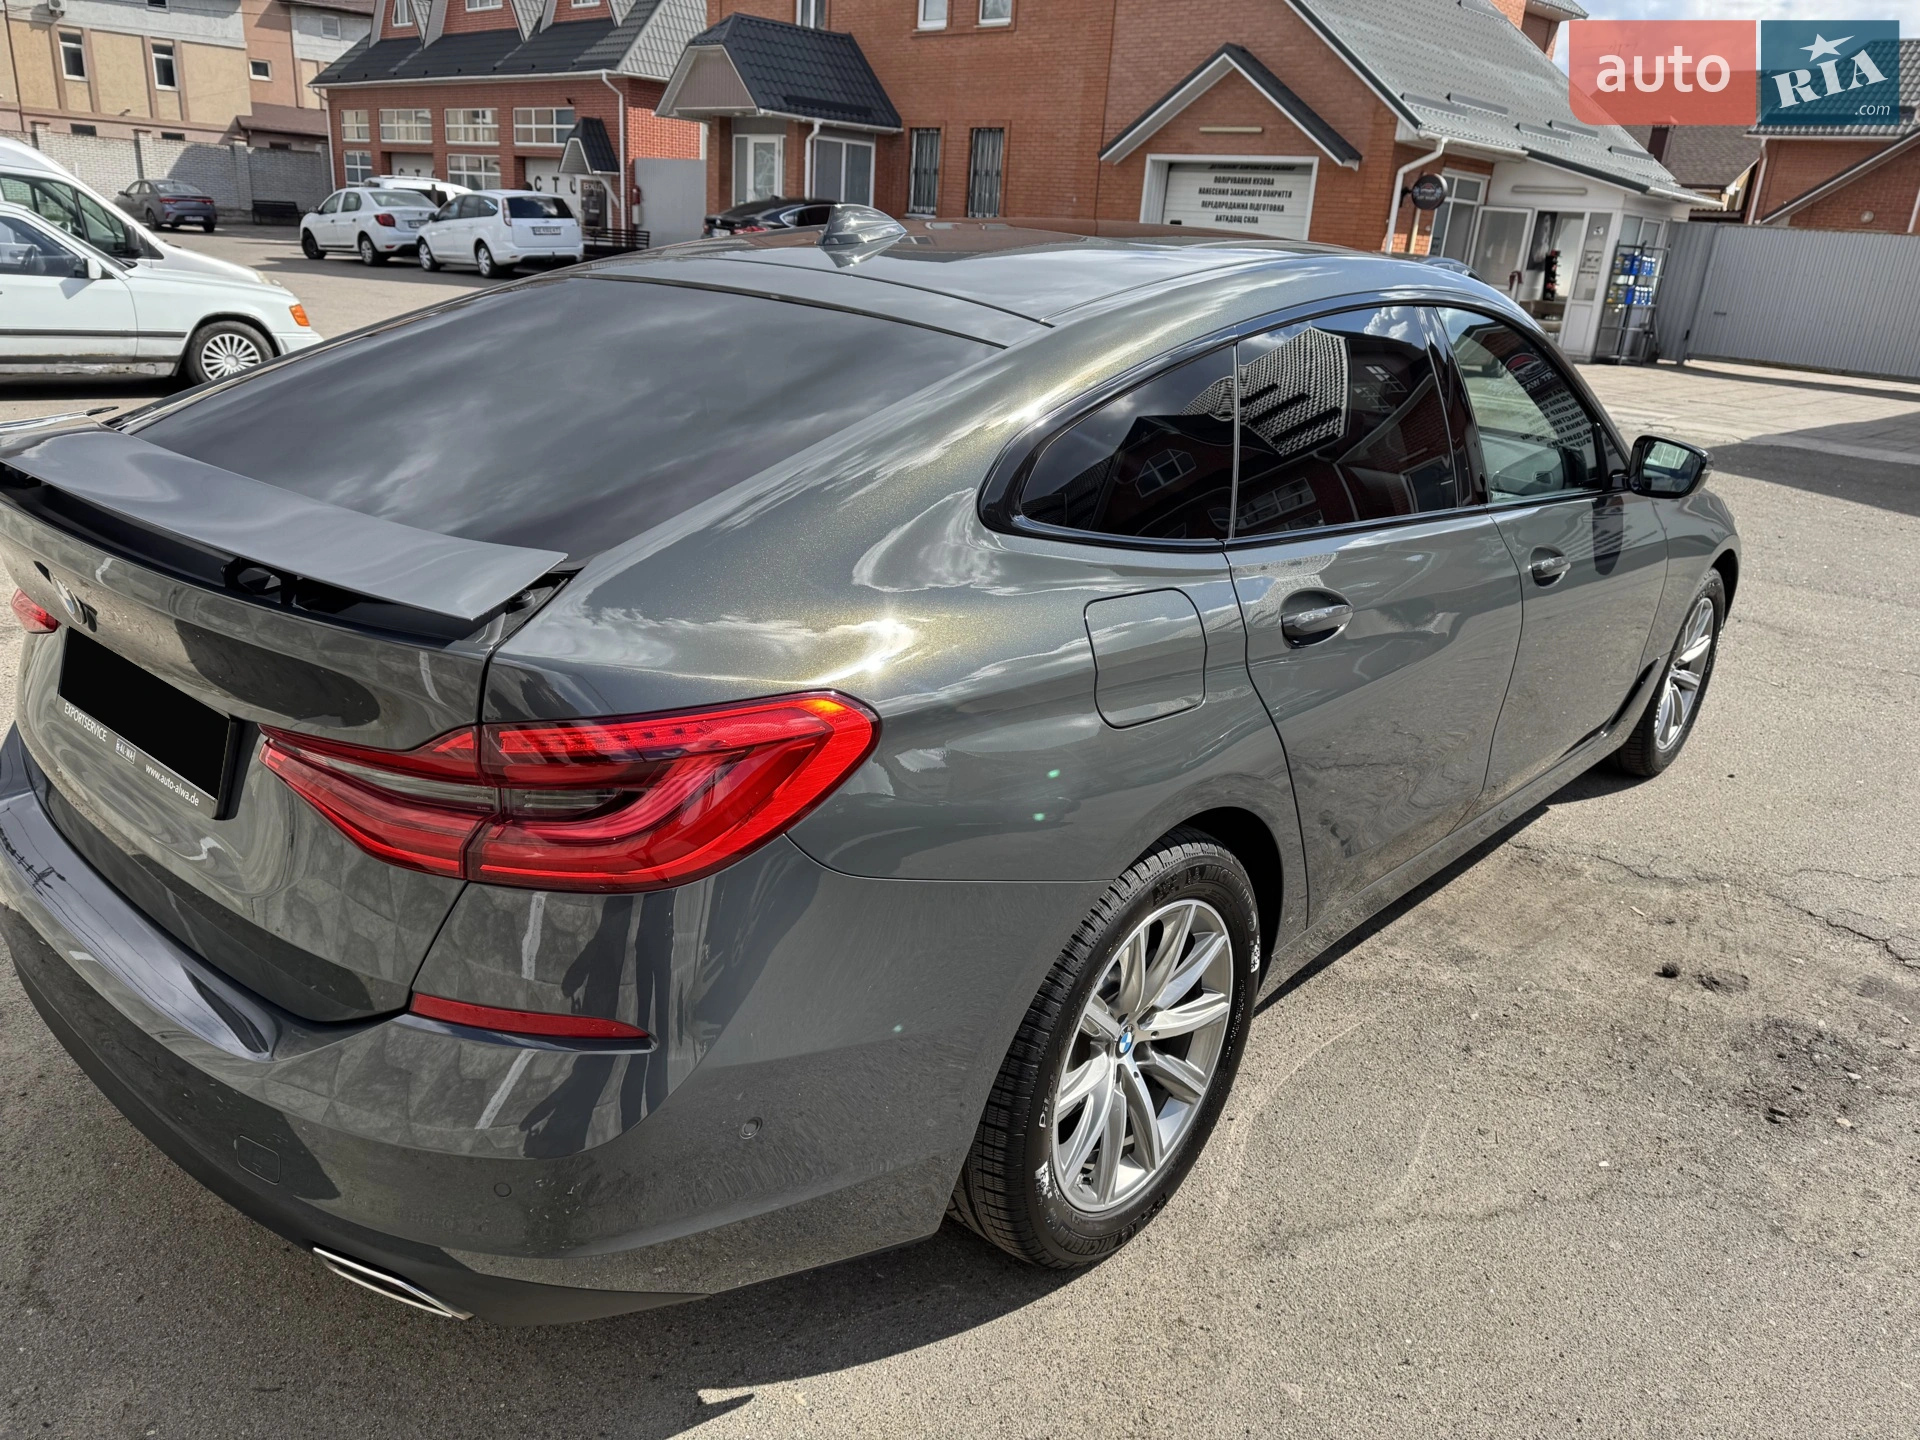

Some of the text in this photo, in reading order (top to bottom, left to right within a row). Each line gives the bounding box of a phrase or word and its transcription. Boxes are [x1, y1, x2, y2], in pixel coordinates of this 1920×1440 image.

[1252, 177, 1275, 186] КУЗОВА
[1262, 189, 1293, 199] ПОКРИТТЯ
[1248, 202, 1285, 213] ПІДГОТОВКА
[1215, 214, 1243, 224] АНТИДОЩ
[64, 702, 107, 742] EXPORTSERVICE
[145, 763, 199, 806] www.auto-alwa.de
